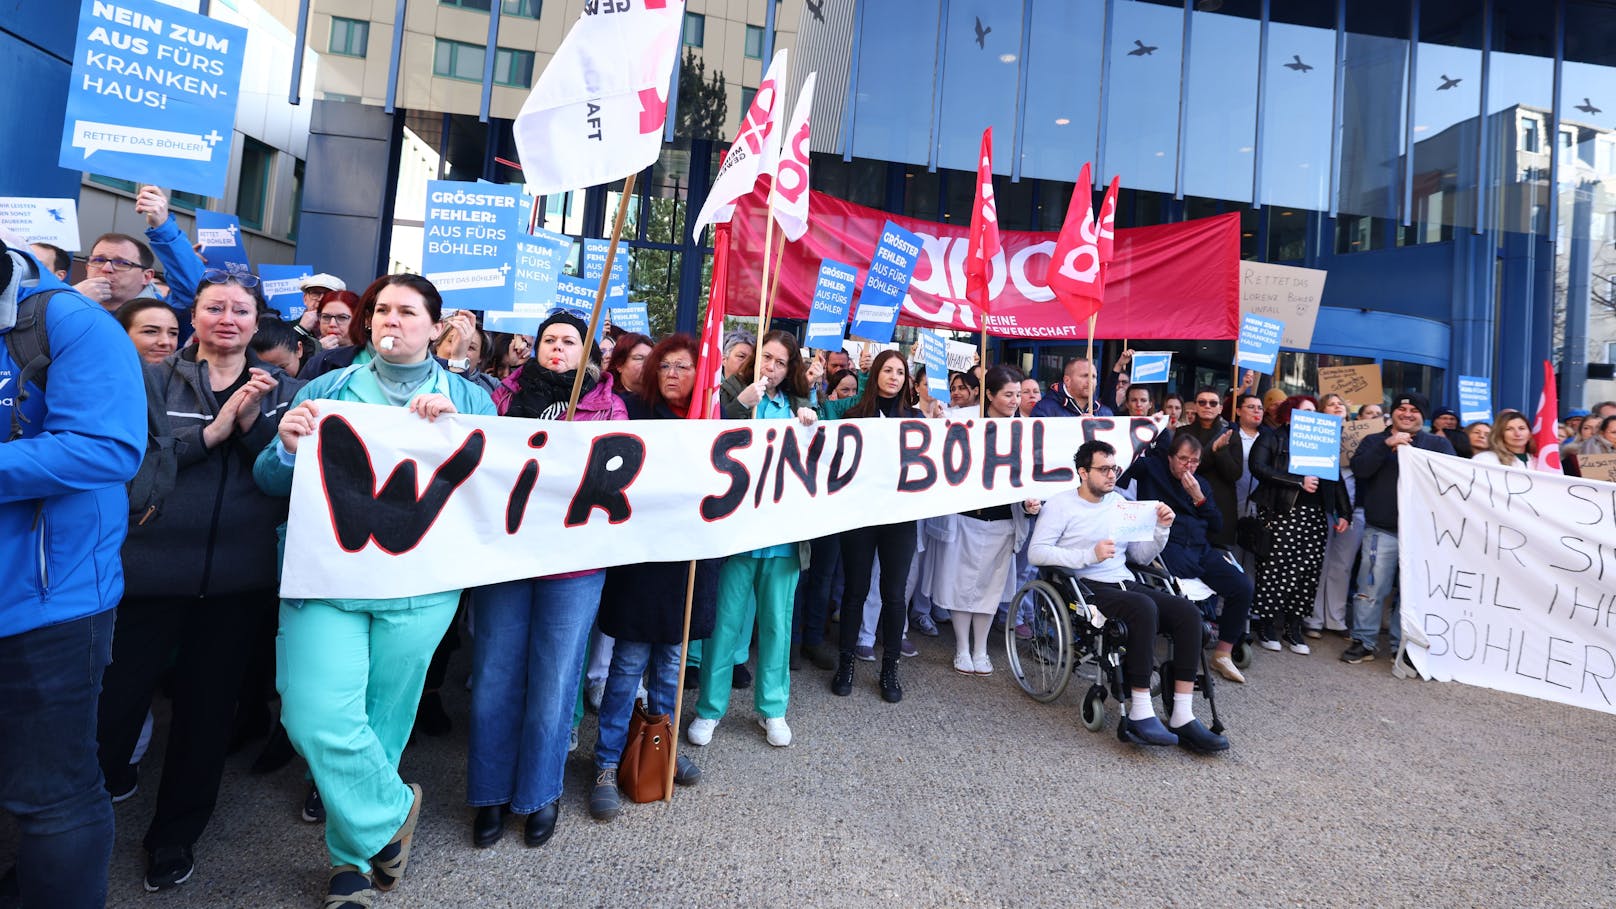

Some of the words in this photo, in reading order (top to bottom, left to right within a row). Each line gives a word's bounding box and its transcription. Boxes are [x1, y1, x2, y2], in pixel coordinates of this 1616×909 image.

[92, 0, 163, 35] NEIN
[169, 23, 230, 54] ZUM
[87, 26, 149, 55] AUS
[156, 44, 225, 76] FÜRS
[86, 49, 228, 99] KRANKEN-
[82, 74, 167, 110] HAUS!
[586, 102, 602, 141] AFT
[83, 130, 127, 144] RETTET
[129, 136, 154, 147] DAS
[431, 189, 516, 208] GRÖSSTER
[430, 208, 497, 224] FEHLER:
[429, 225, 461, 238] AUS
[465, 225, 506, 241] FÜRS
[428, 240, 498, 257] BÖHLER!
[526, 243, 553, 257] ZUM
[883, 231, 919, 257] GRÖSSTER
[521, 254, 551, 270] FÜRS
[877, 246, 907, 269] FEHLER:
[516, 268, 554, 282] NKEN-
[821, 265, 855, 283] GRÖSSTER
[872, 262, 889, 277] AUS
[887, 267, 907, 285] FÜRS
[816, 289, 831, 301] AUS
[818, 277, 847, 293] FEHLER:
[867, 276, 899, 298] BÖHLER!
[556, 293, 593, 310] EHLER:
[813, 300, 843, 316] BÖHLER!
[1427, 458, 1540, 518] WIR
[1432, 511, 1527, 568] WIR
[1549, 535, 1616, 582] SI
[1425, 559, 1521, 612] WEIL
[1424, 608, 1616, 706] BÖHLER
